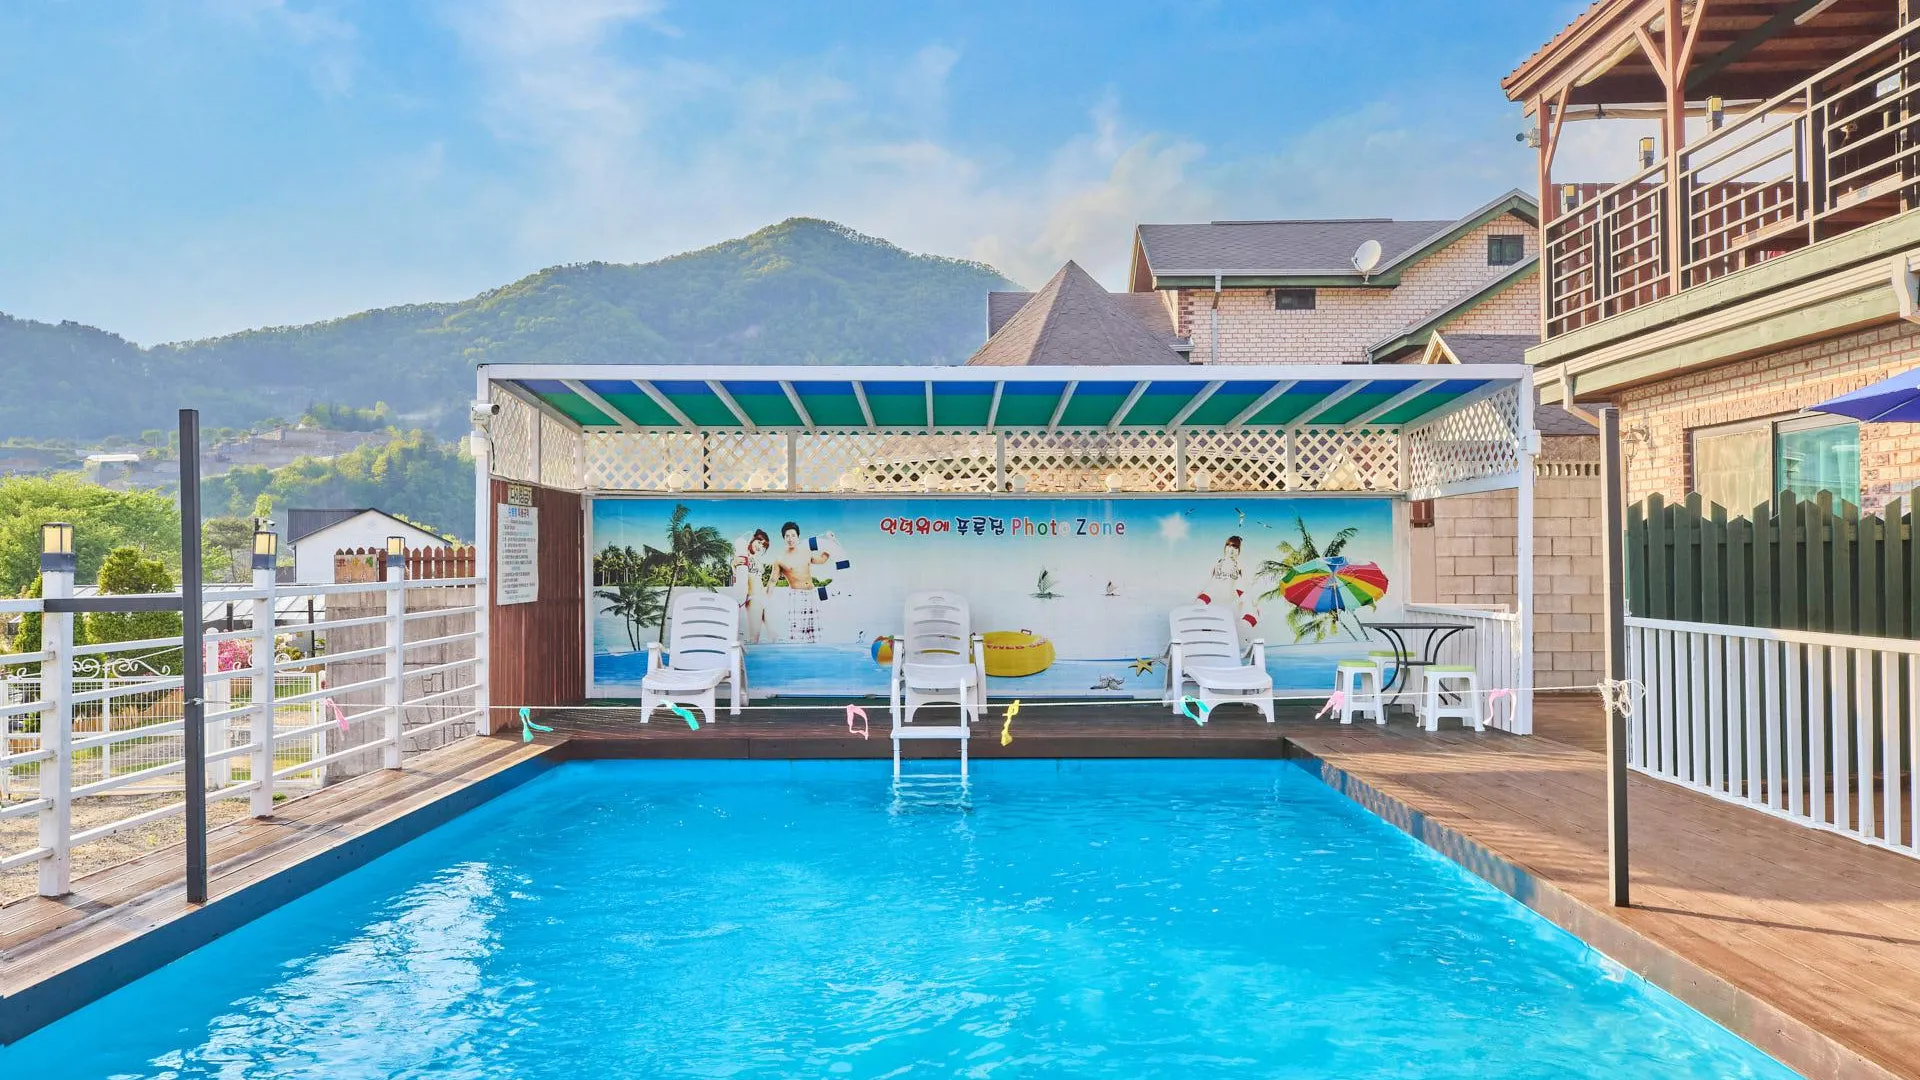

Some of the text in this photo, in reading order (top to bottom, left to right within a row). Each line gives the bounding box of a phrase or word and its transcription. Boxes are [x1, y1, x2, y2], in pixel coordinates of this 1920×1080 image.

[880, 516, 1125, 536] 언덕위에 푸른집 Photo Zone
